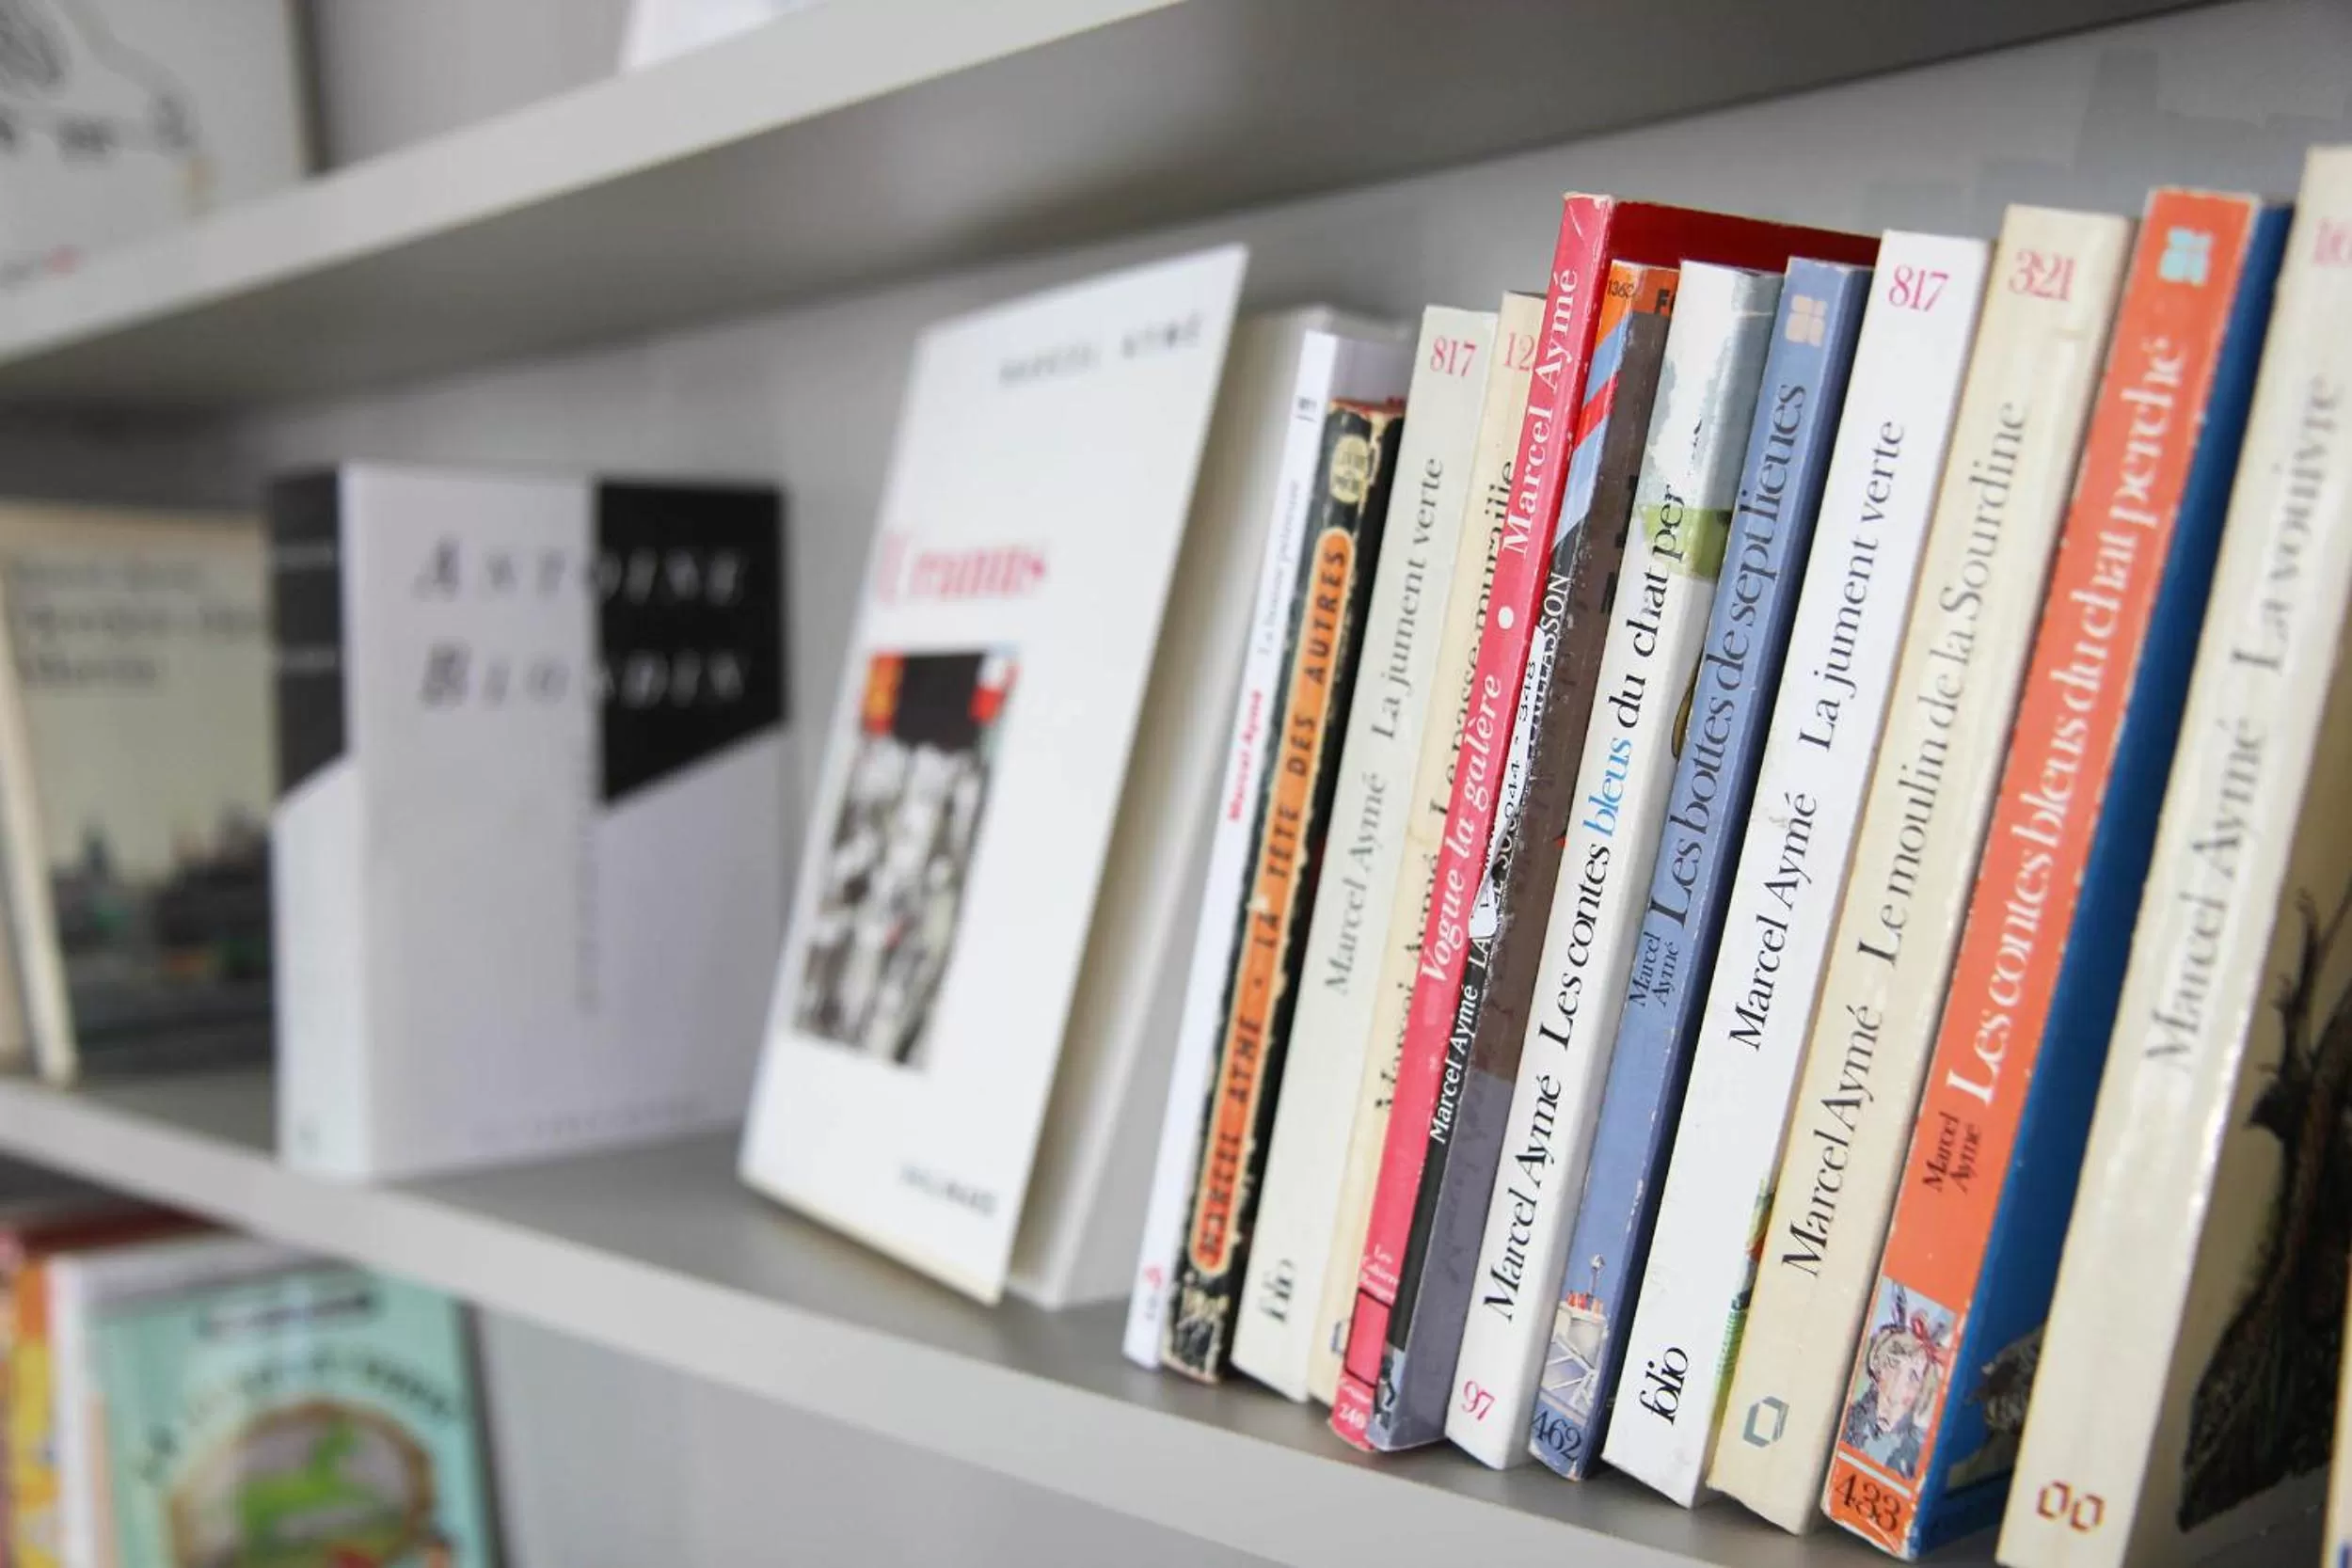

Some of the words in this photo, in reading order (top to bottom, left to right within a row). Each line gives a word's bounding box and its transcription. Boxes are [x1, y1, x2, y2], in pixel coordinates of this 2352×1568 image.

[1887, 264, 1950, 313] 817
[2008, 248, 2076, 302] 321
[1429, 337, 1477, 377] 817
[1502, 404, 1552, 556] Marcel
[1534, 267, 1579, 392] Aymé
[1739, 383, 1806, 522] lieues
[2111, 337, 2188, 529] perché
[1413, 457, 1444, 545] verte
[1861, 420, 1905, 525] verte
[1939, 401, 2030, 621] Sourdine
[1380, 558, 1426, 694] jument
[1626, 563, 1669, 657] chat
[1729, 523, 1779, 629] sept
[1812, 535, 1880, 700] jument
[2070, 529, 2138, 637] chat
[1608, 673, 1646, 729] du
[1705, 628, 1750, 691] de
[1917, 669, 1963, 730] de
[1931, 626, 1975, 674] la
[2049, 638, 2109, 713] du
[1253, 912, 1279, 948] LA
[1285, 713, 1315, 777] DES
[1304, 548, 1345, 685] AUTRES
[1371, 696, 1400, 739] La
[1669, 694, 1736, 836] bottes
[1797, 698, 1841, 753] La
[2145, 889, 2224, 1071] Marcel
[2192, 715, 2267, 882] Aymé
[2231, 593, 2290, 674] La
[2266, 374, 2341, 584] vouivre
[1348, 770, 1387, 872] Aymé
[1421, 868, 1466, 983] Vogue
[1445, 816, 1476, 859] la
[1463, 673, 1502, 812] galère
[1582, 735, 1633, 837] bleus
[1886, 733, 1950, 899] moulin
[2010, 721, 2087, 849] bleus
[1649, 836, 1704, 929] Les
[1762, 790, 1819, 912] Aymé
[1323, 877, 1367, 997] Marcel
[1560, 844, 1611, 968] contes
[1857, 903, 1906, 969] Le
[1989, 851, 2052, 1006] contes
[1539, 972, 1583, 1052] Les
[1627, 930, 1662, 1009] Marcel
[1648, 939, 1683, 1009] Aymé
[1728, 910, 1789, 1052] Marcel
[1429, 1056, 1462, 1145] Marcel
[1450, 984, 1479, 1054] Aymé
[1468, 935, 1492, 971] LA
[1820, 1004, 1883, 1132] Aymé
[1947, 1008, 2009, 1107] Les
[1515, 1074, 1562, 1190] Aymé
[1921, 1111, 1960, 1194] Marcel
[1484, 1187, 1542, 1323] Marcel
[1782, 1131, 1851, 1277] Marcel
[1461, 1379, 1496, 1422] 97
[1531, 1410, 1582, 1462] 462
[1640, 1346, 1689, 1426] folio
[1836, 1473, 1901, 1535] 433
